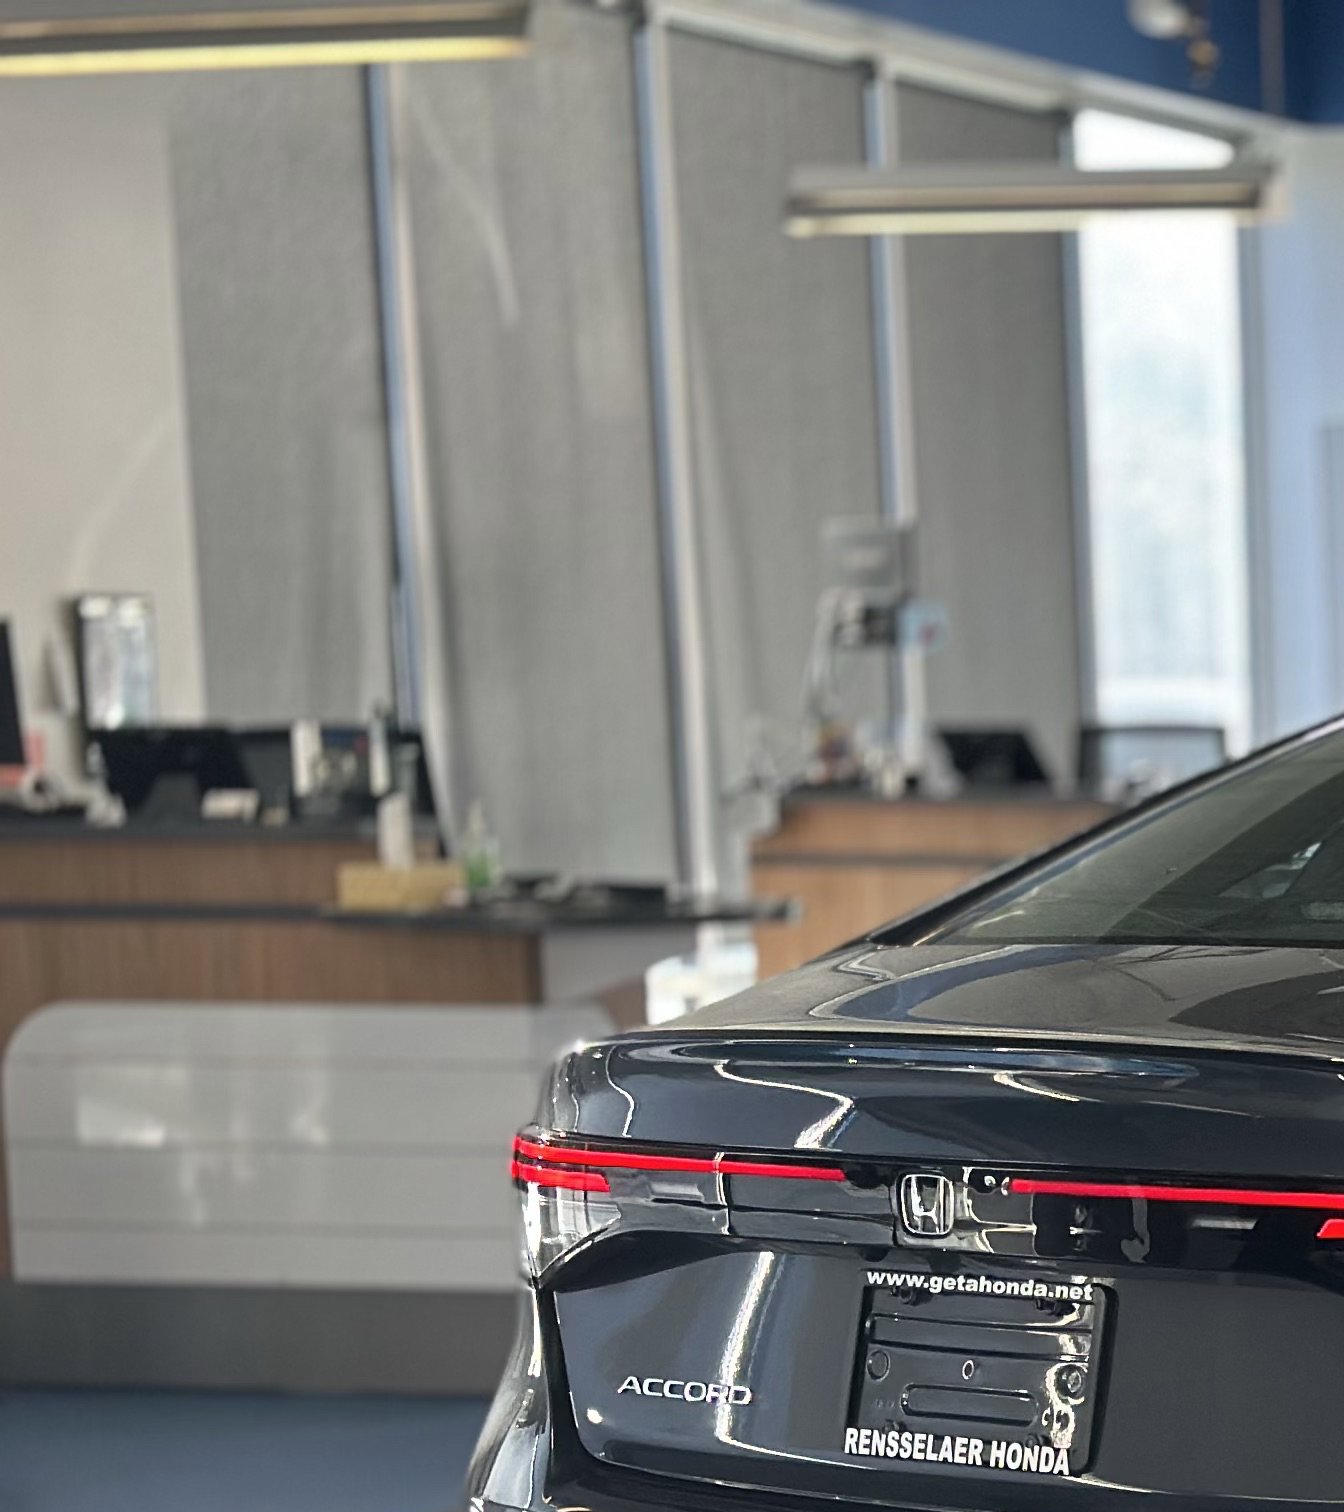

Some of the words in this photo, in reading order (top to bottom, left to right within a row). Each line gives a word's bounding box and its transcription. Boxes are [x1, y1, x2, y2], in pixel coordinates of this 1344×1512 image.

[867, 1271, 1094, 1301] www.getahonda.net
[617, 1375, 753, 1405] ACCORD
[844, 1427, 984, 1466] RENSSELAER
[989, 1440, 1070, 1476] HONDA
